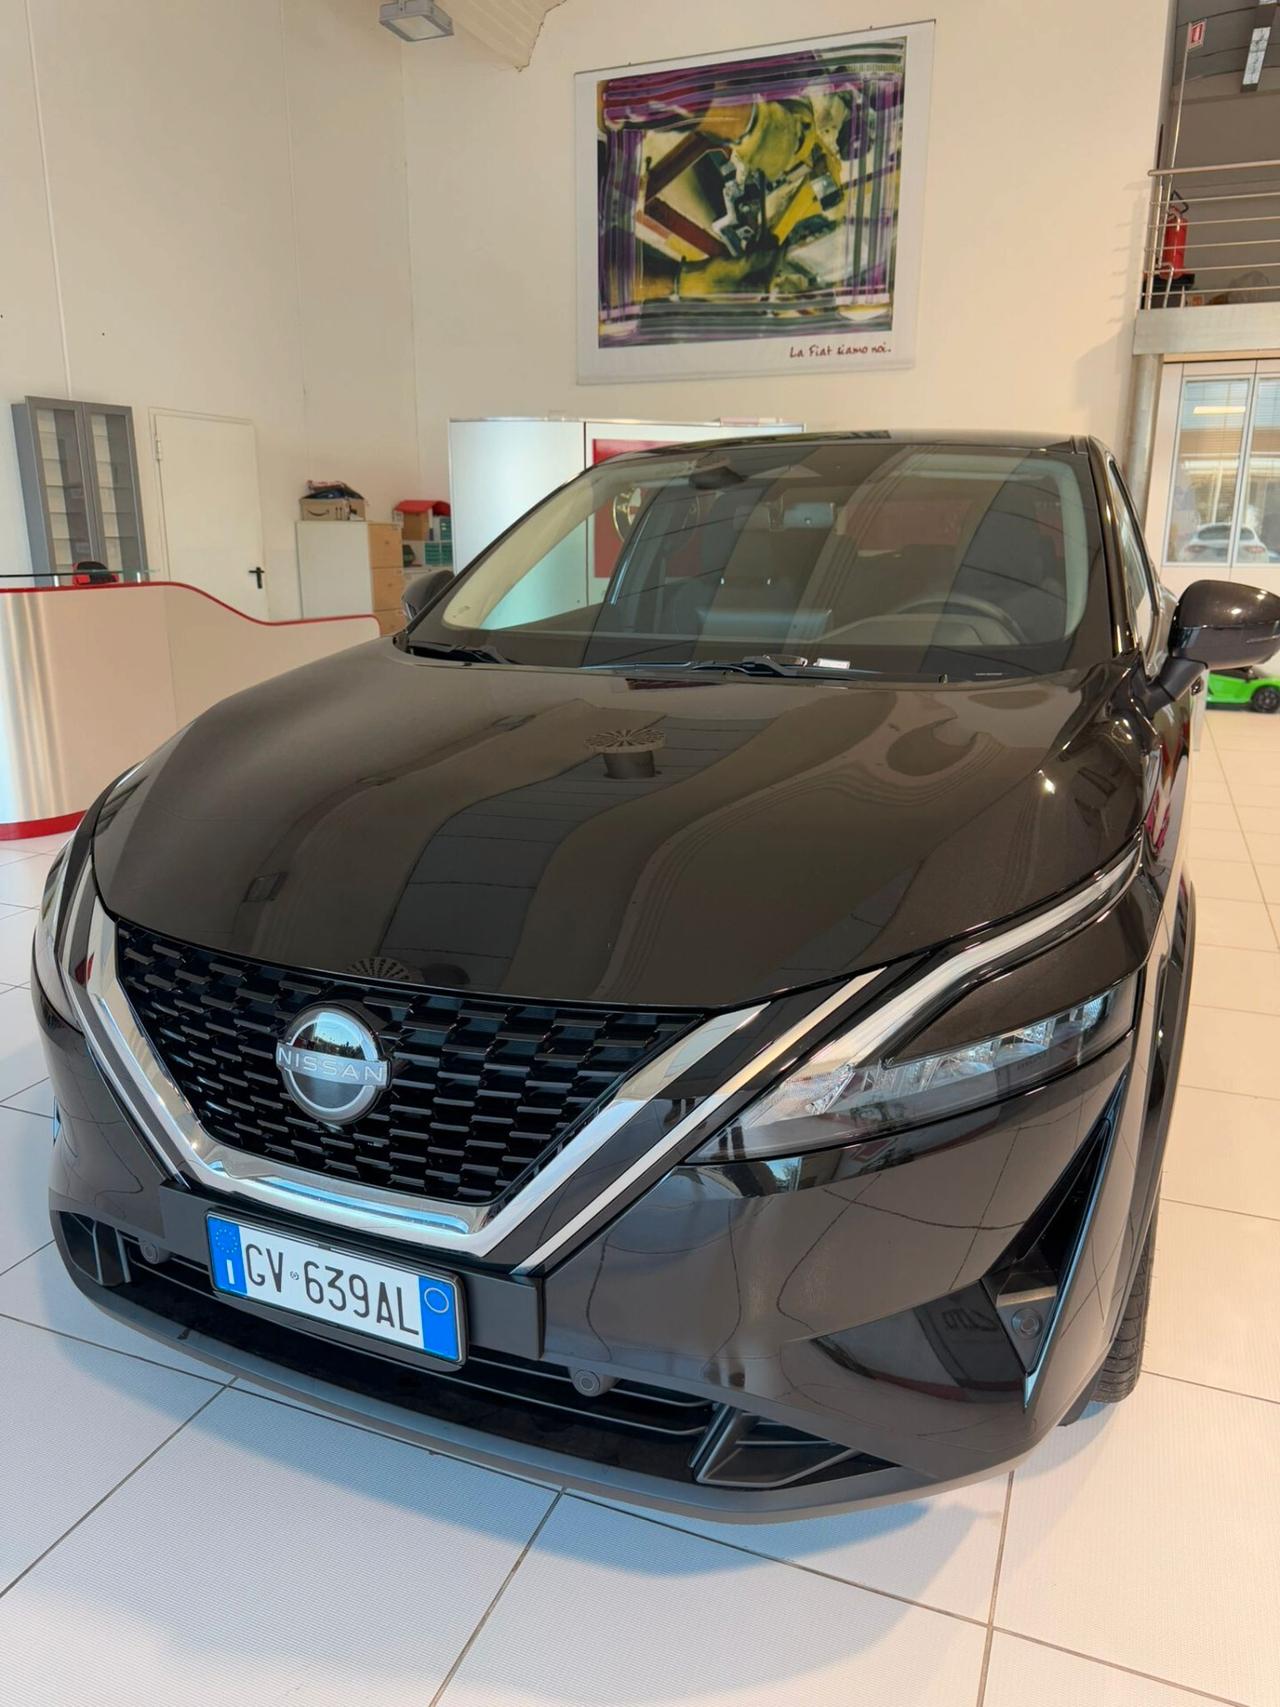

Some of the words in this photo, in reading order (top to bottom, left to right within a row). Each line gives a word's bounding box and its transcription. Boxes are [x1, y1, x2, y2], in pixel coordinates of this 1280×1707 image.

[790, 346, 804, 358] La
[809, 344, 832, 356] Fiat
[871, 341, 892, 353] noi.
[278, 1047, 383, 1081] NISSAN
